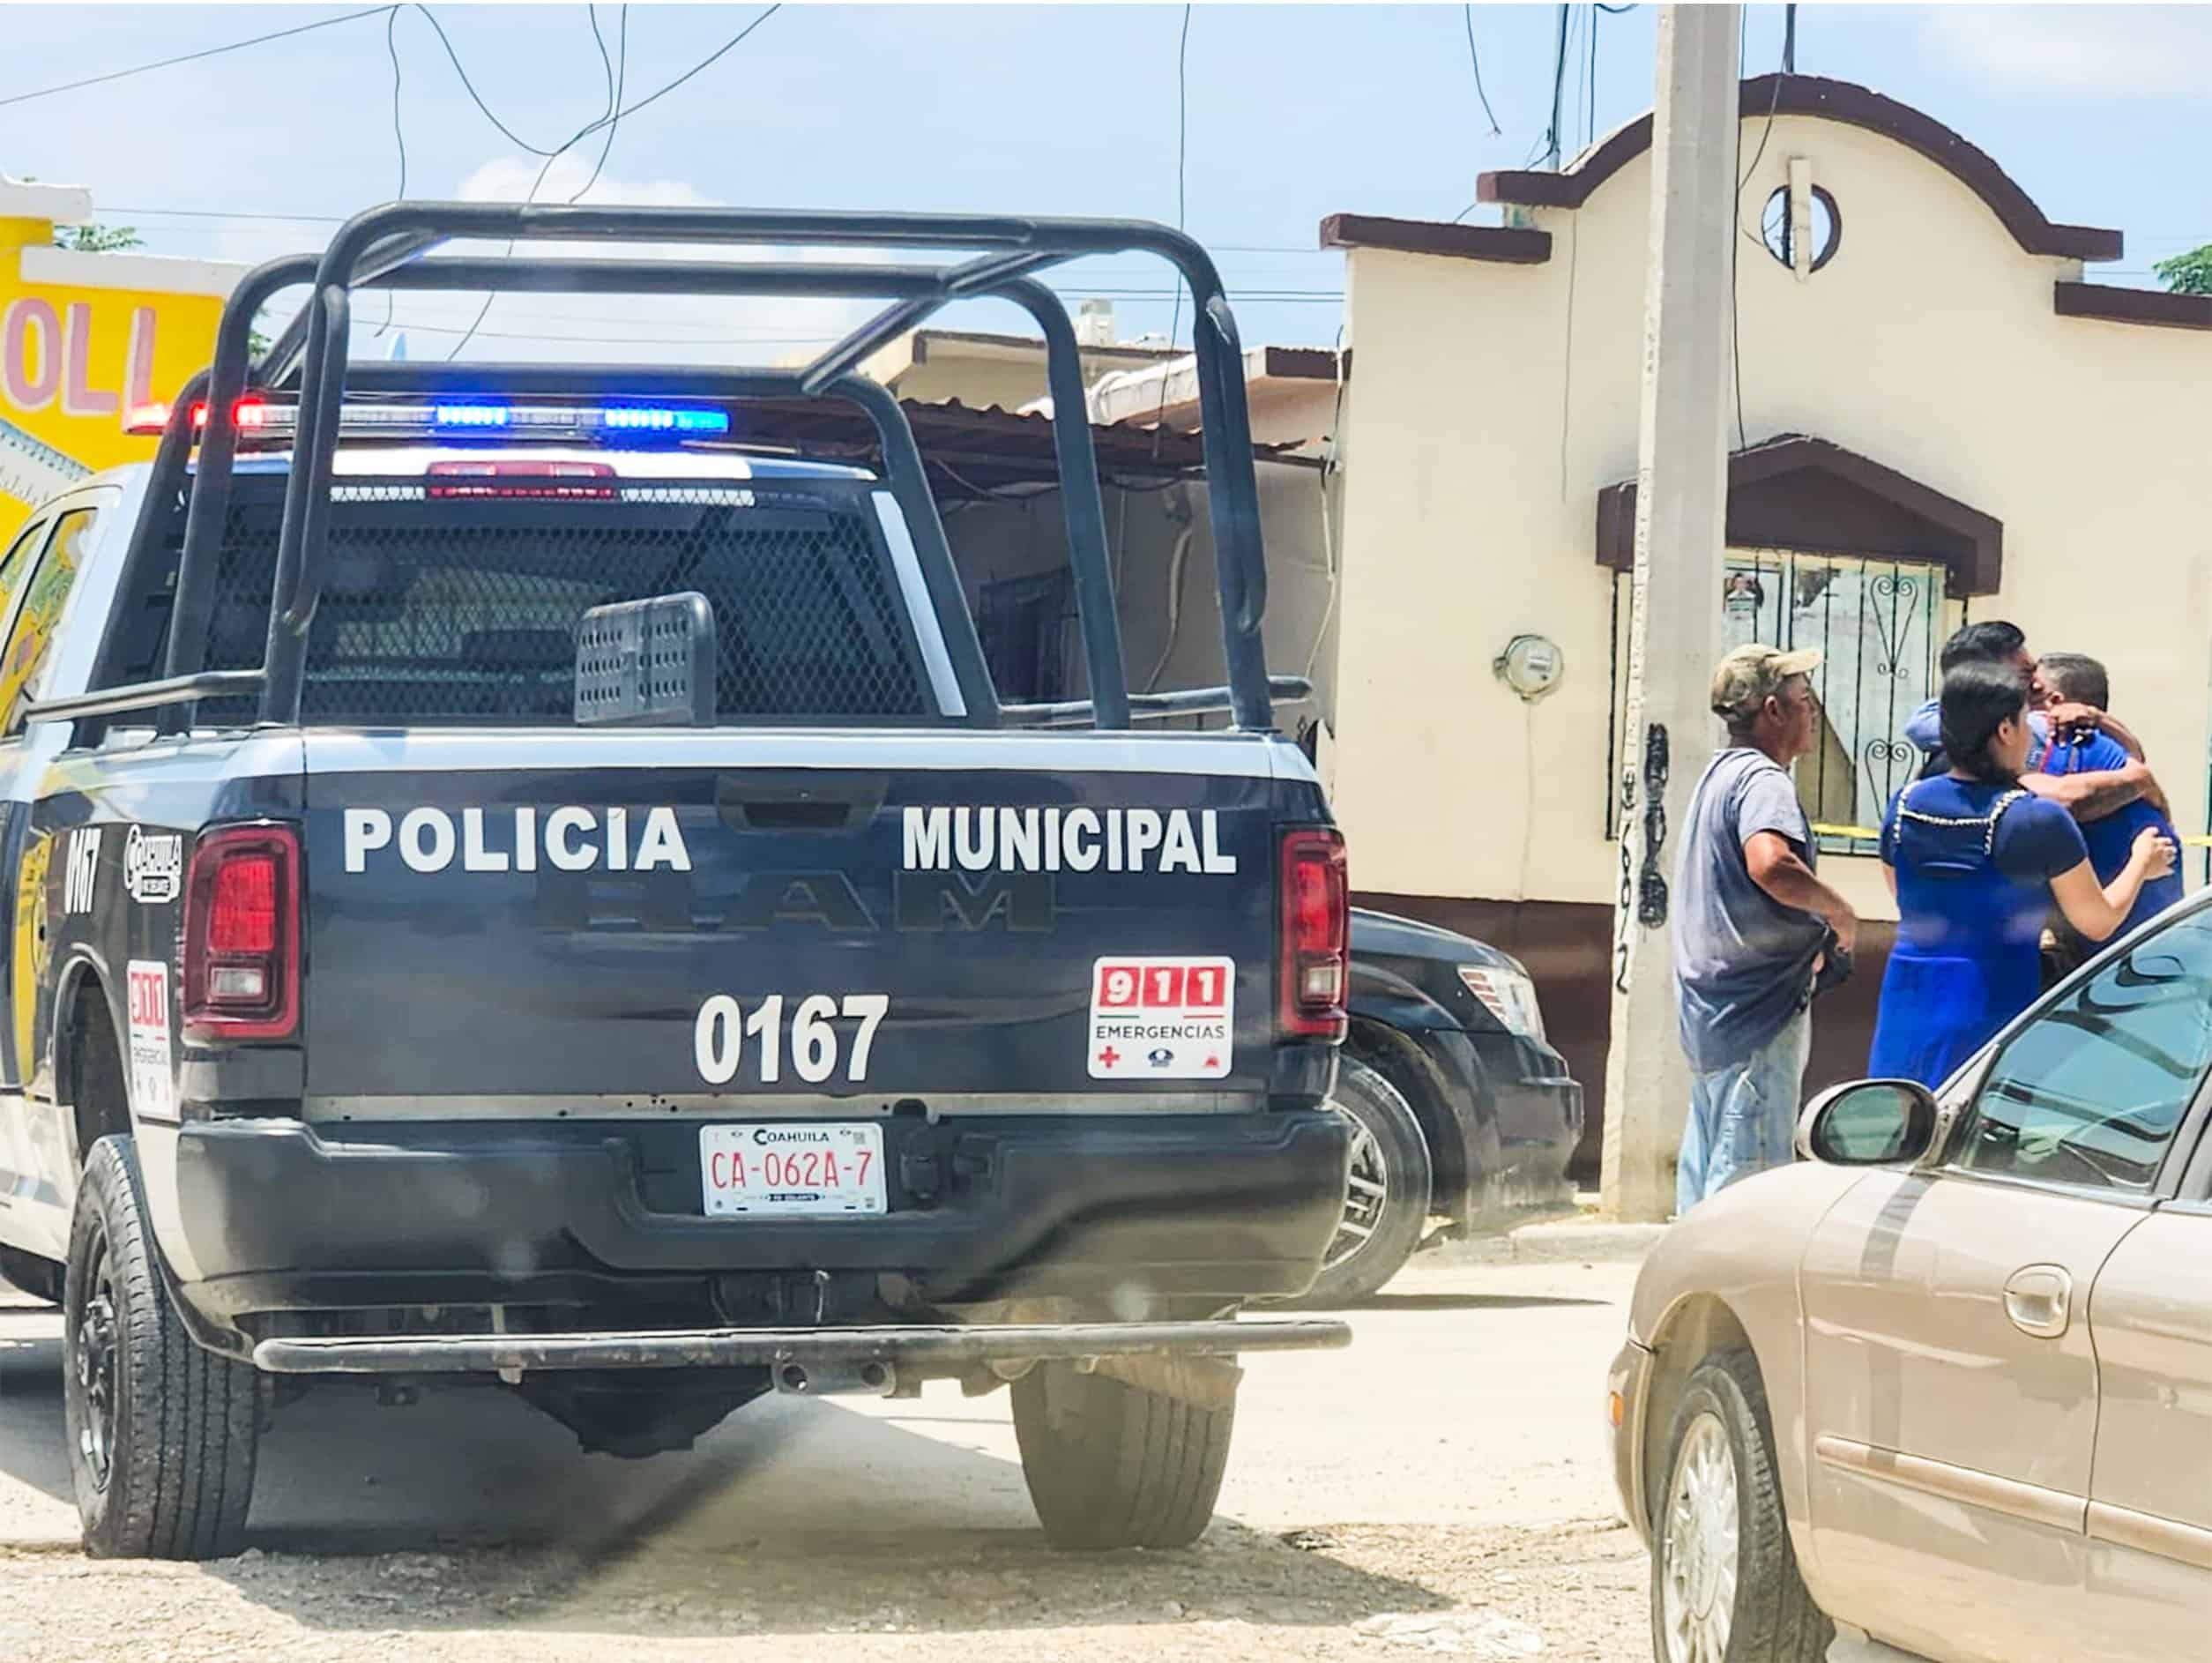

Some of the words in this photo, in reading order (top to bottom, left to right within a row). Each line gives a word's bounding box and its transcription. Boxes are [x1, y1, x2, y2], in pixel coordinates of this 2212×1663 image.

[903, 806, 1237, 874] MUNICIPAL
[536, 869, 1058, 932] RAM
[1104, 967, 1218, 1005] 911
[695, 994, 890, 1085] 0167
[1095, 1025, 1225, 1040] EMERGENCIAS
[711, 1150, 873, 1189] CA-062A-7
